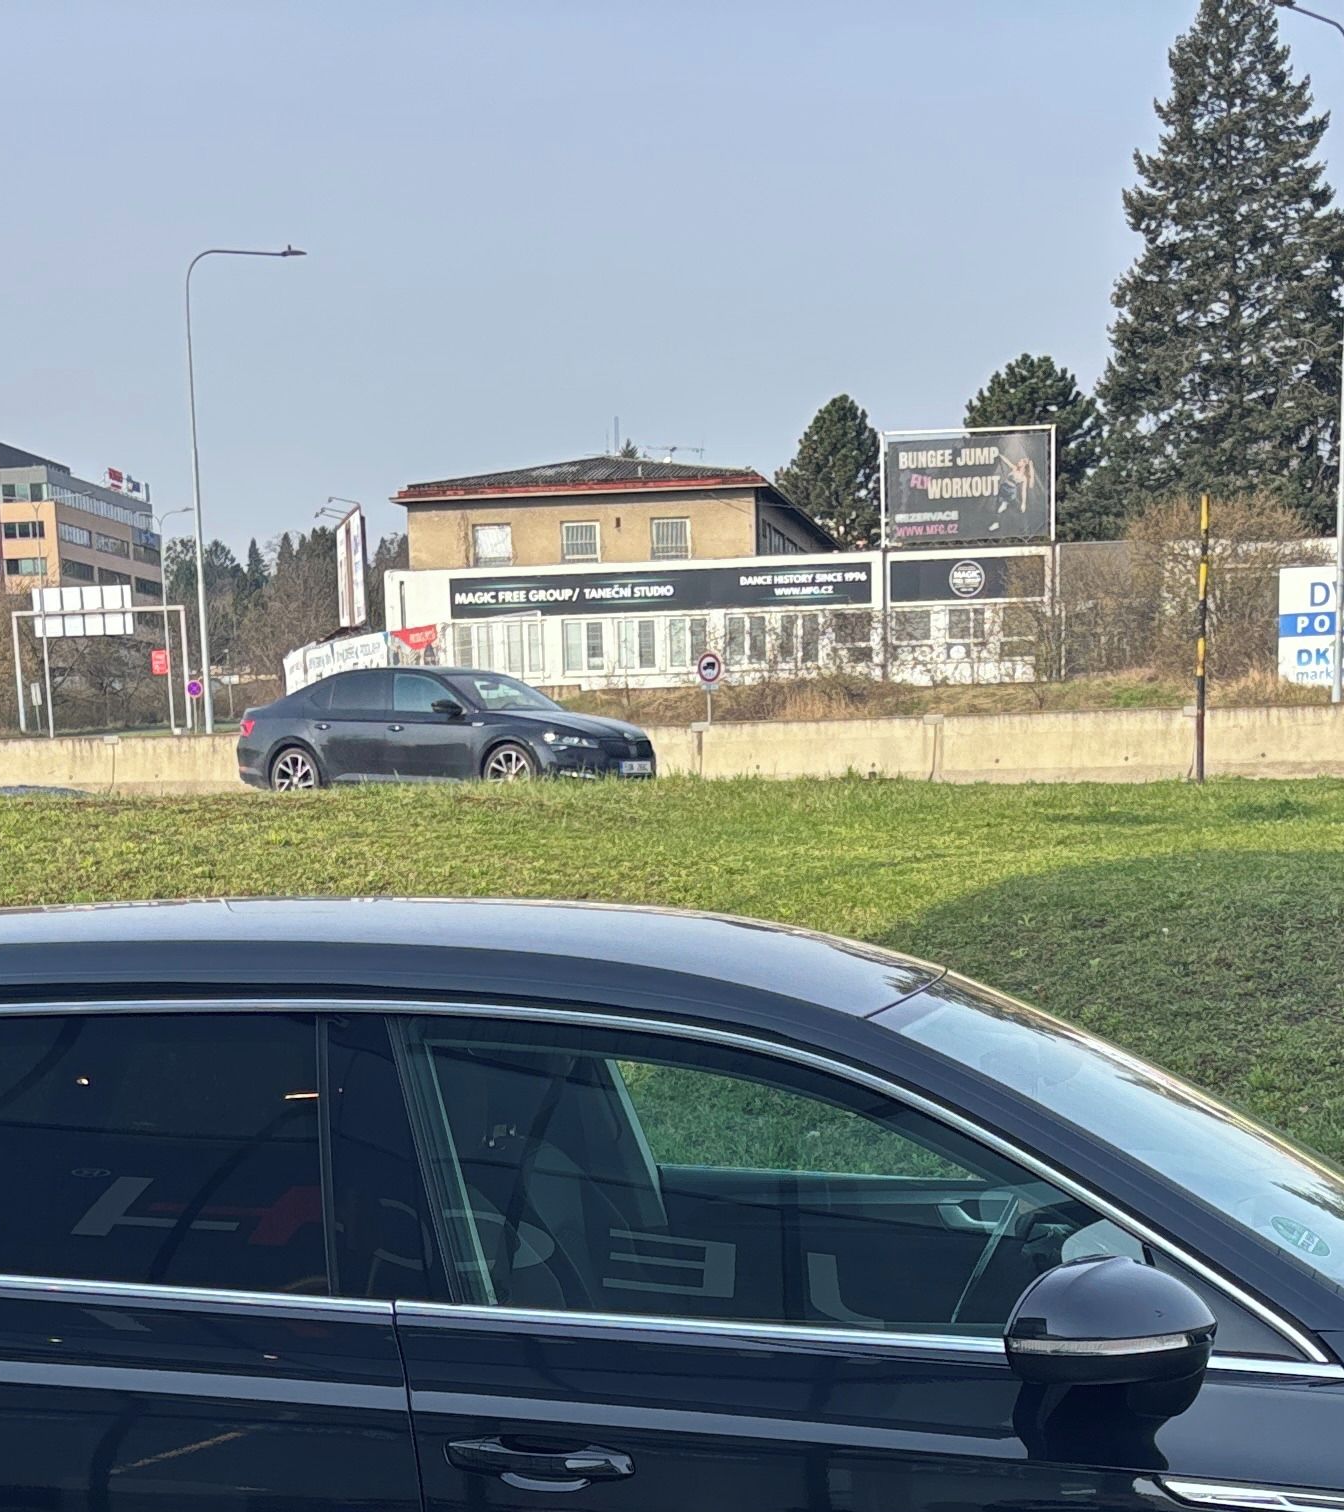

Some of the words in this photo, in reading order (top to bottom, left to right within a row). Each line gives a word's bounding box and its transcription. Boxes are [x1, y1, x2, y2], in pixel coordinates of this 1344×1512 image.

[899, 450, 953, 469] BUNGEE
[956, 447, 1000, 466] JUMP
[928, 476, 1000, 499] WORKOUT
[740, 575, 772, 585] DANCE
[774, 574, 814, 584] HISTORY
[815, 573, 843, 583] SINCE
[843, 572, 867, 582] 1996
[455, 591, 496, 605] MAGIC
[498, 590, 527, 603] FREE
[584, 584, 632, 599] TANEČNÍ
[634, 585, 674, 597] STUDIO
[774, 585, 834, 596] WWW.MFG.CZ
